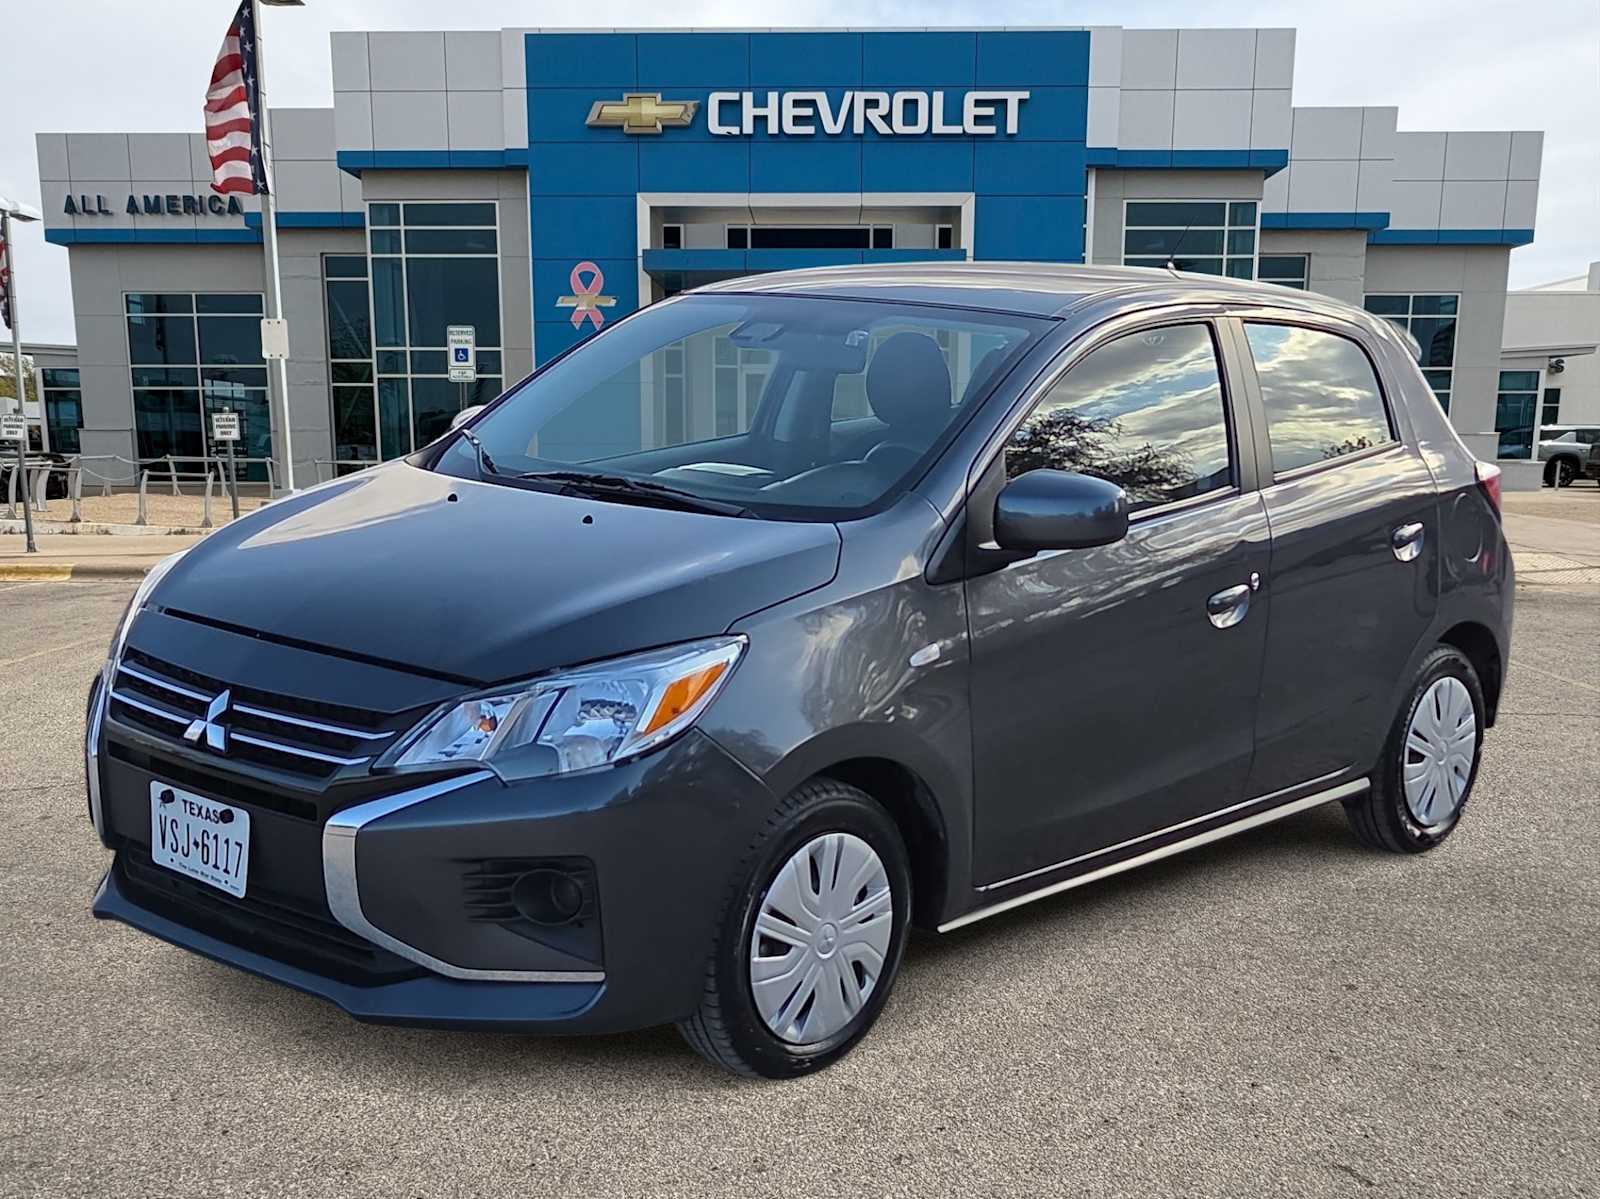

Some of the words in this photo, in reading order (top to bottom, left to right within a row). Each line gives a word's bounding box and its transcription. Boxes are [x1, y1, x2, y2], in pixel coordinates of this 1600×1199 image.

[707, 90, 1030, 135] CHEVROLET
[64, 194, 112, 216] ALL
[126, 194, 244, 216] AMERICA
[182, 798, 221, 824] TEXAS
